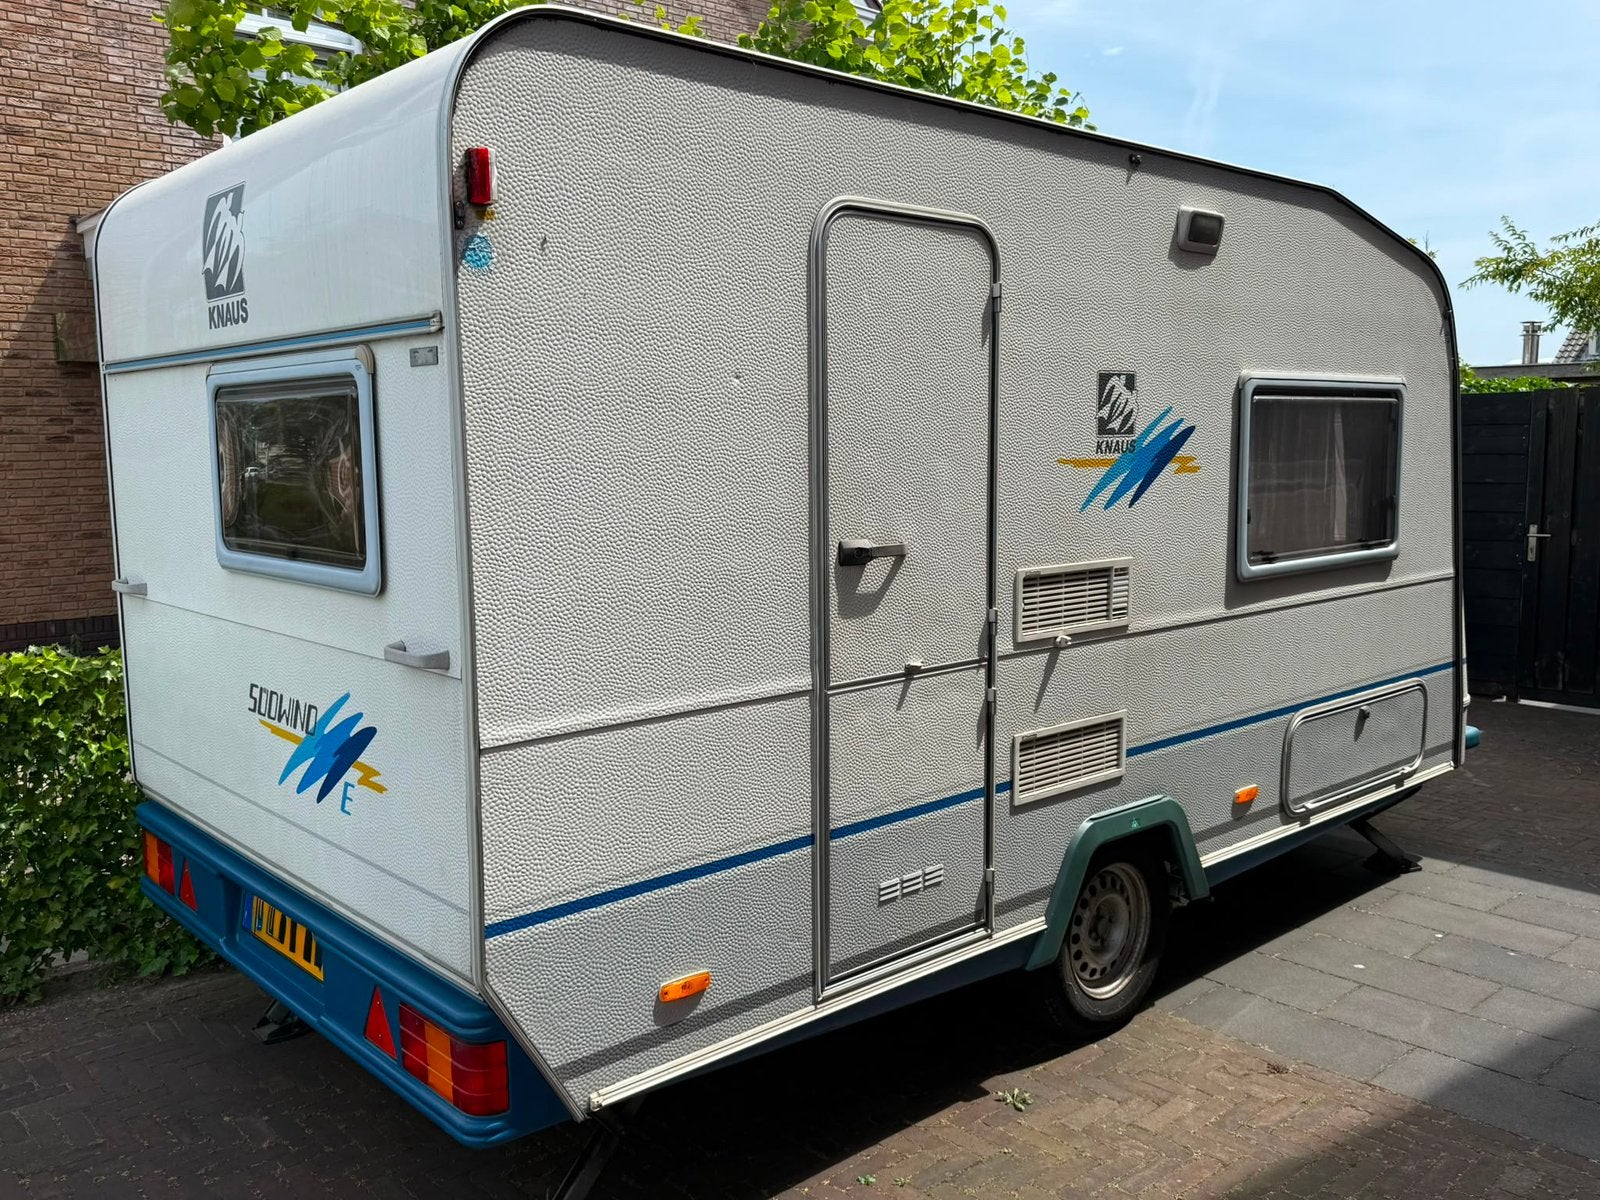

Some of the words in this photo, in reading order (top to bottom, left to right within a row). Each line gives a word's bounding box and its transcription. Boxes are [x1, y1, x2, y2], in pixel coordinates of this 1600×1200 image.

[208, 297, 249, 330] KNAUS
[1095, 439, 1136, 454] KNAUS
[340, 781, 355, 816] E
